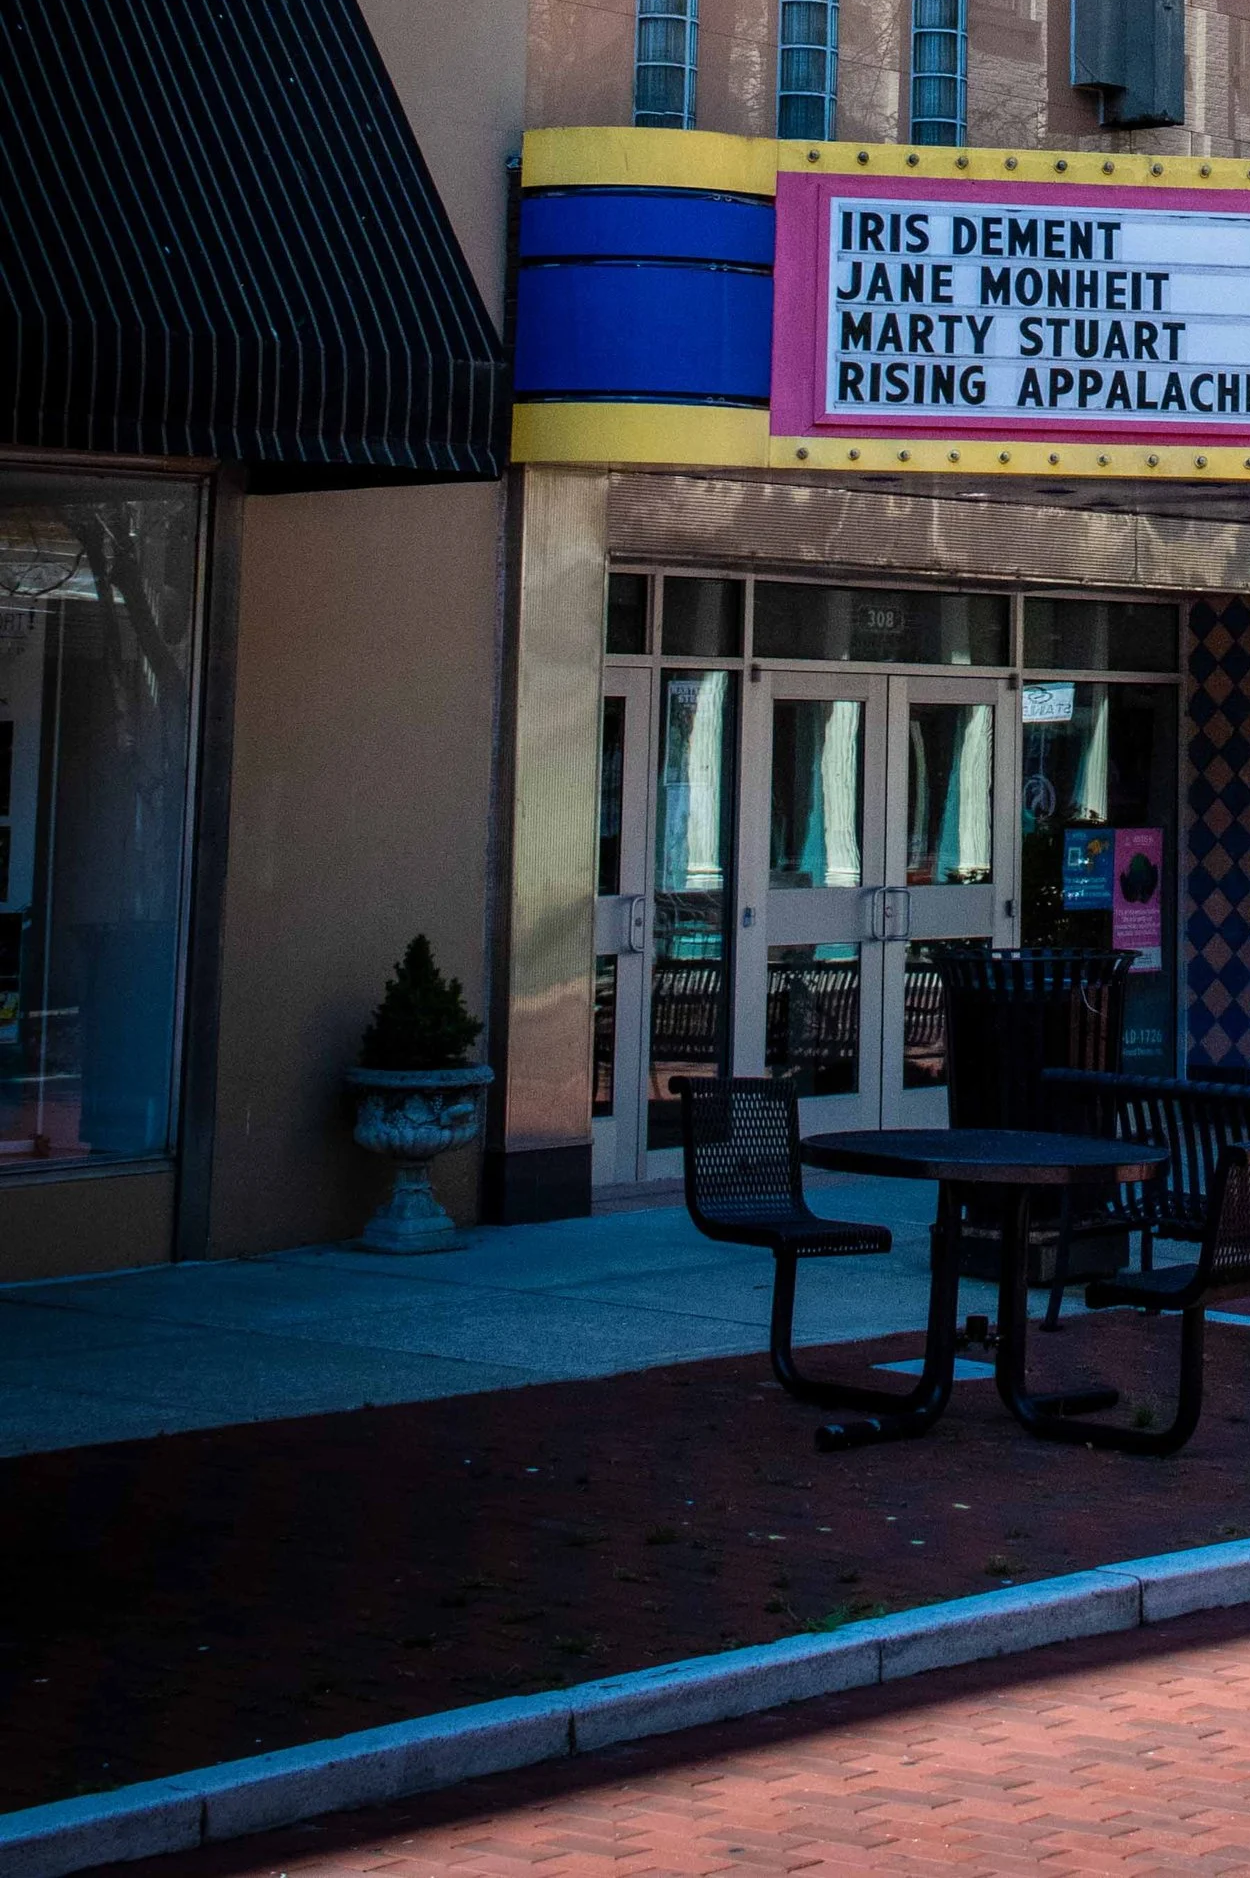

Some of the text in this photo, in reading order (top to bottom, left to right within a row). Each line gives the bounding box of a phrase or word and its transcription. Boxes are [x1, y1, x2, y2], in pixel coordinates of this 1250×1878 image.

[840, 210, 930, 254] IRIS
[952, 215, 1121, 260] DEMENT
[836, 261, 955, 303] JANE
[980, 267, 1170, 312] MONHEIT
[840, 311, 994, 354] MARTY
[1020, 317, 1187, 361] STUART
[837, 361, 987, 407] RISING
[867, 610, 895, 628] 308
